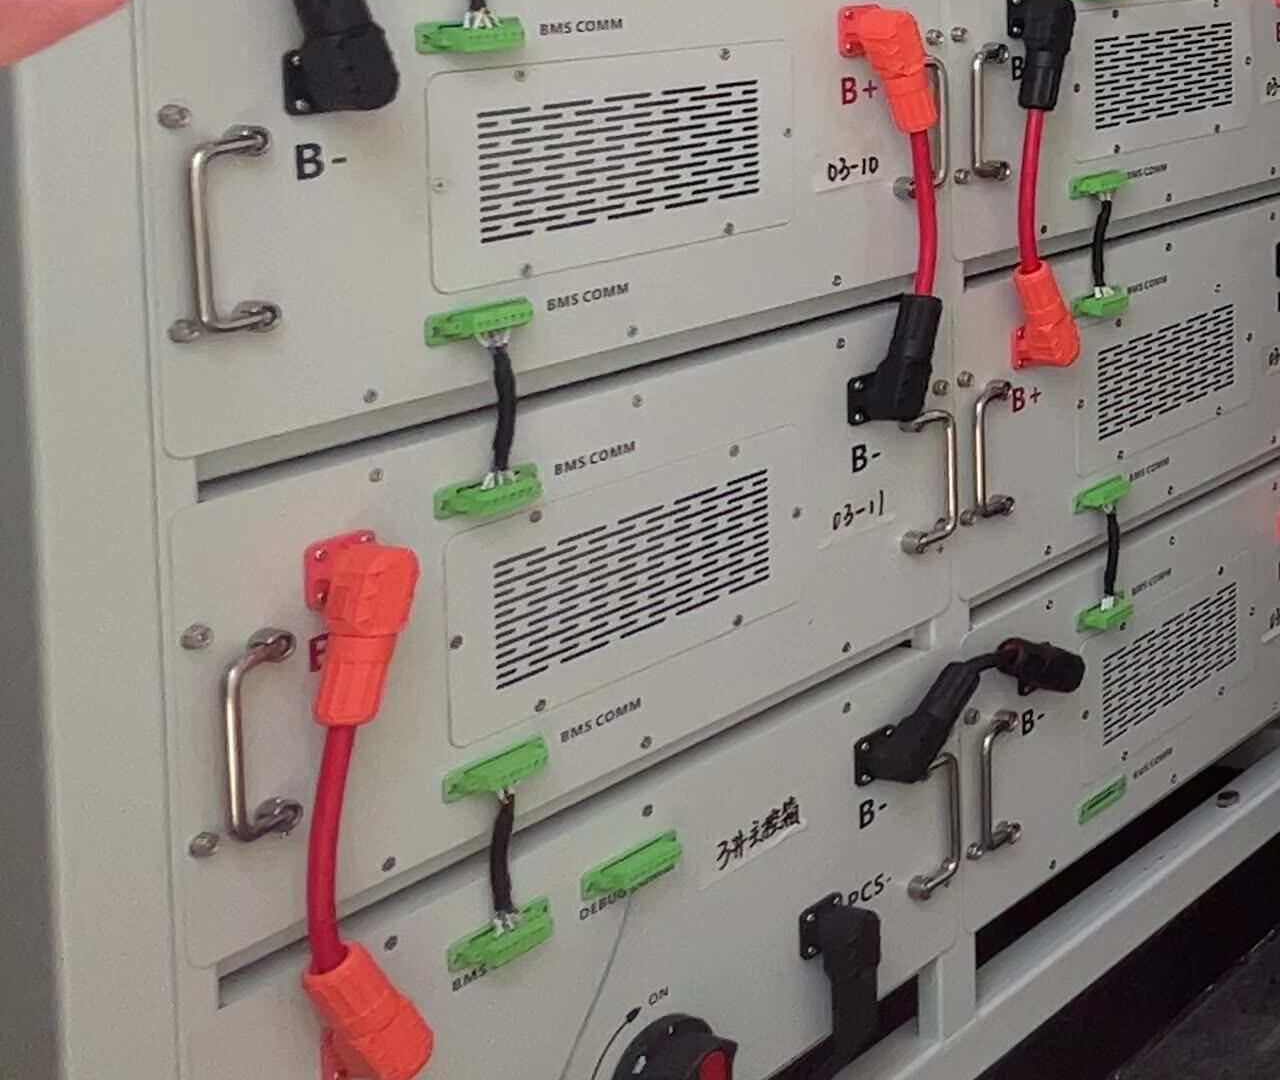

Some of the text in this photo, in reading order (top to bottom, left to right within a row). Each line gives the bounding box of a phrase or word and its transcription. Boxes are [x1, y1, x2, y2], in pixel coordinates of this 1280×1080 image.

[539, 17, 623, 36] BMS COMM
[841, 76, 878, 105] B+
[296, 143, 347, 182] B-
[827, 157, 879, 182] 03-10
[546, 281, 630, 311] BMS COMM
[1012, 386, 1042, 413] B+
[554, 440, 636, 476] BMS COMM
[851, 443, 881, 473] B-
[832, 489, 884, 530] 03-11
[559, 697, 642, 743] BMS COMM
[1021, 708, 1046, 736] B-
[859, 798, 887, 830] B-
[451, 965, 488, 992] BMS
[648, 986, 669, 1006] ON
